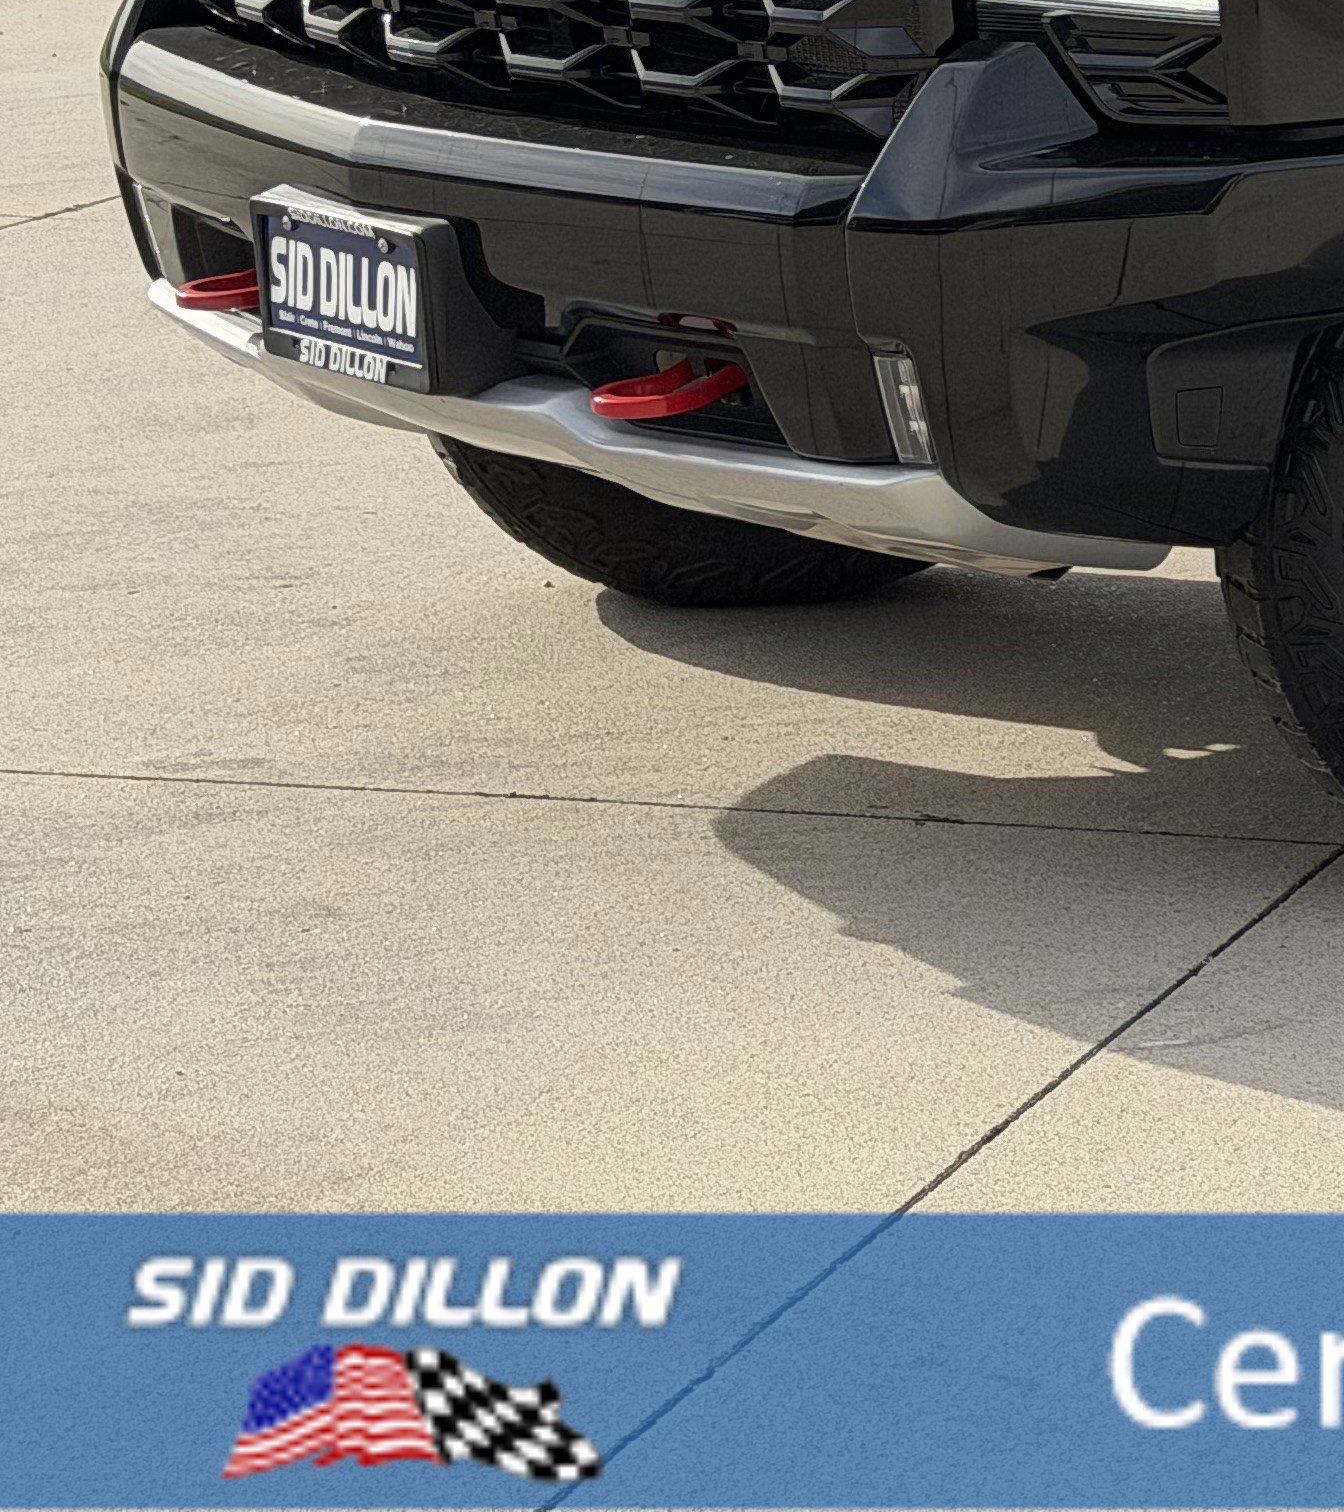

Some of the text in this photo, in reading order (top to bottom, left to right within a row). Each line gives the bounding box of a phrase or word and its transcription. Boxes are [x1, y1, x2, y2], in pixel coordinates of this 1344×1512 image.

[270, 236, 417, 338] SID DILLON
[299, 338, 387, 384] SID DILLON
